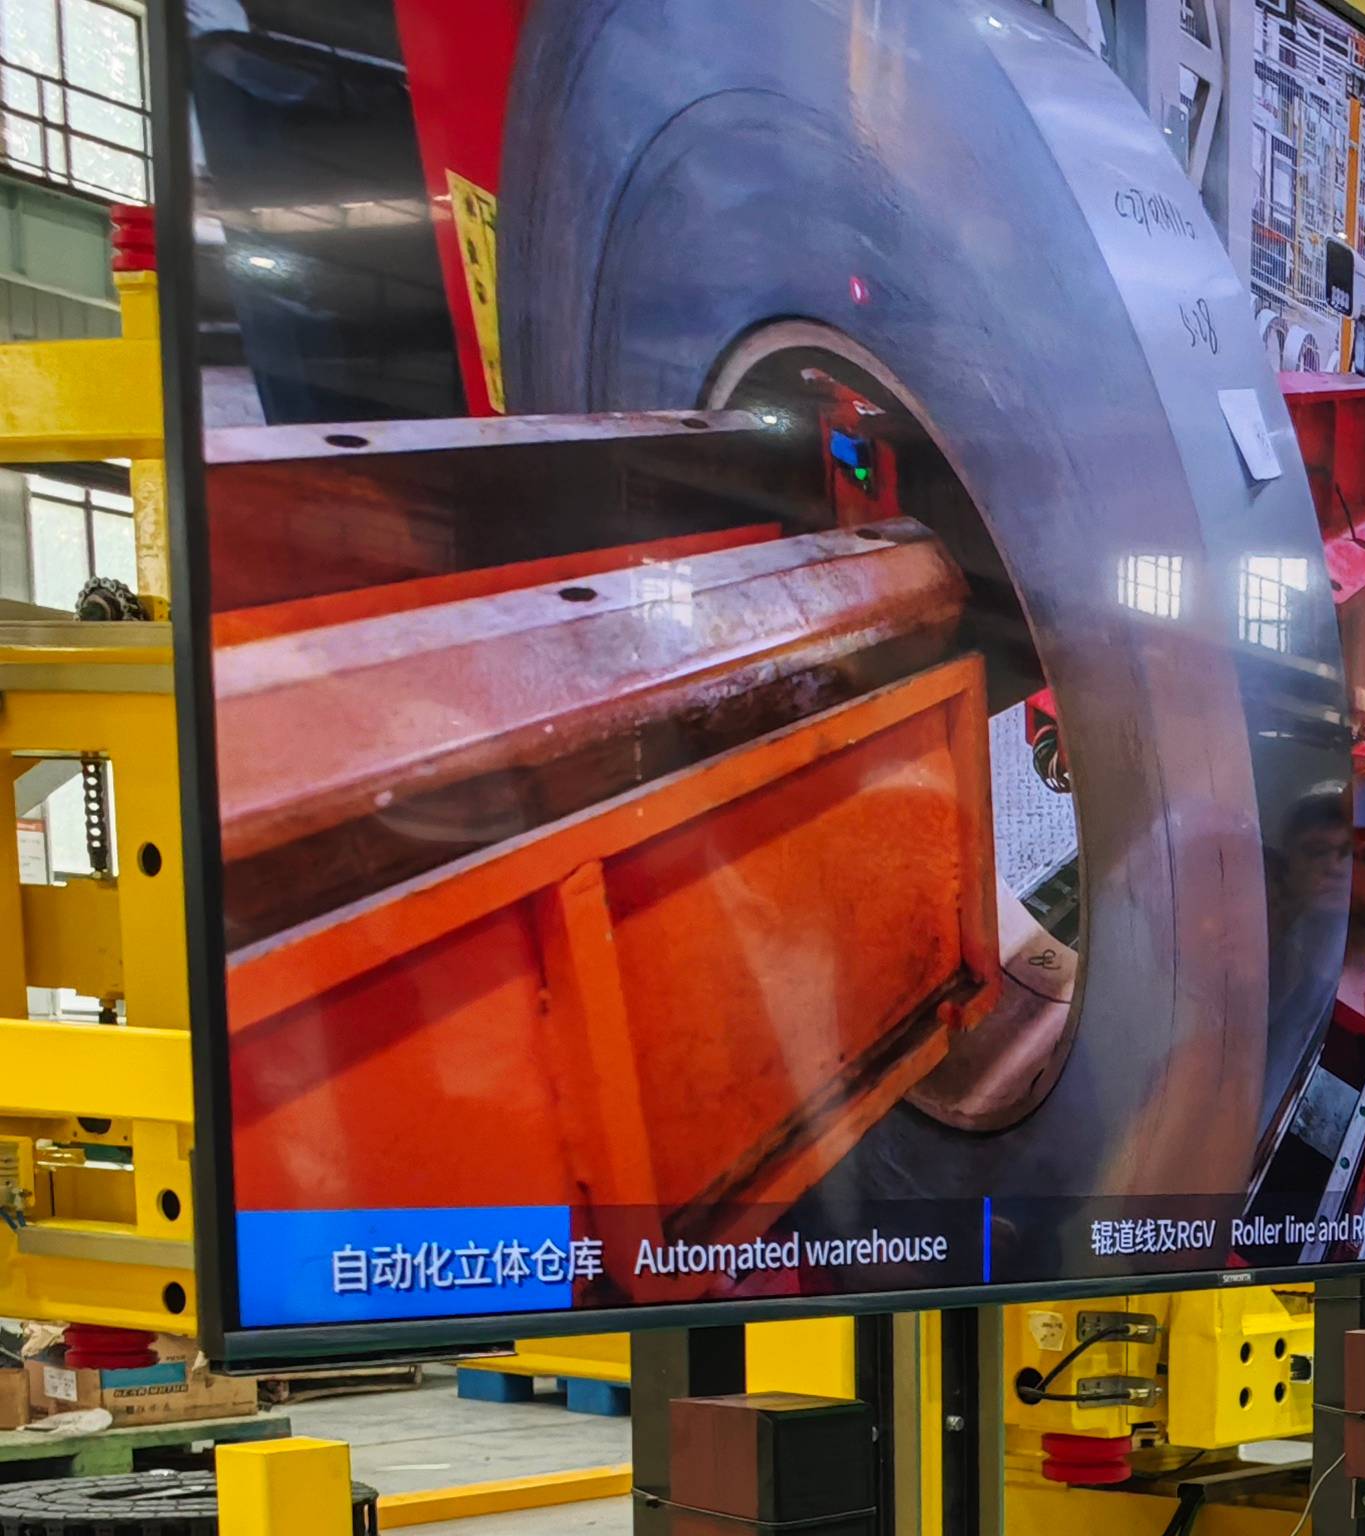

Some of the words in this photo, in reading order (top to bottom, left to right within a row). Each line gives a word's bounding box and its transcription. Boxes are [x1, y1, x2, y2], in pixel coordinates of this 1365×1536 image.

[332, 1237, 604, 1293] 自动化立体仓库
[634, 1231, 799, 1275] Automated
[805, 1228, 948, 1267] warehouse
[1091, 1218, 1216, 1255] 辊道线及RGV
[1231, 1218, 1282, 1246] Roller
[1285, 1215, 1315, 1244] line
[1319, 1213, 1348, 1241] and
